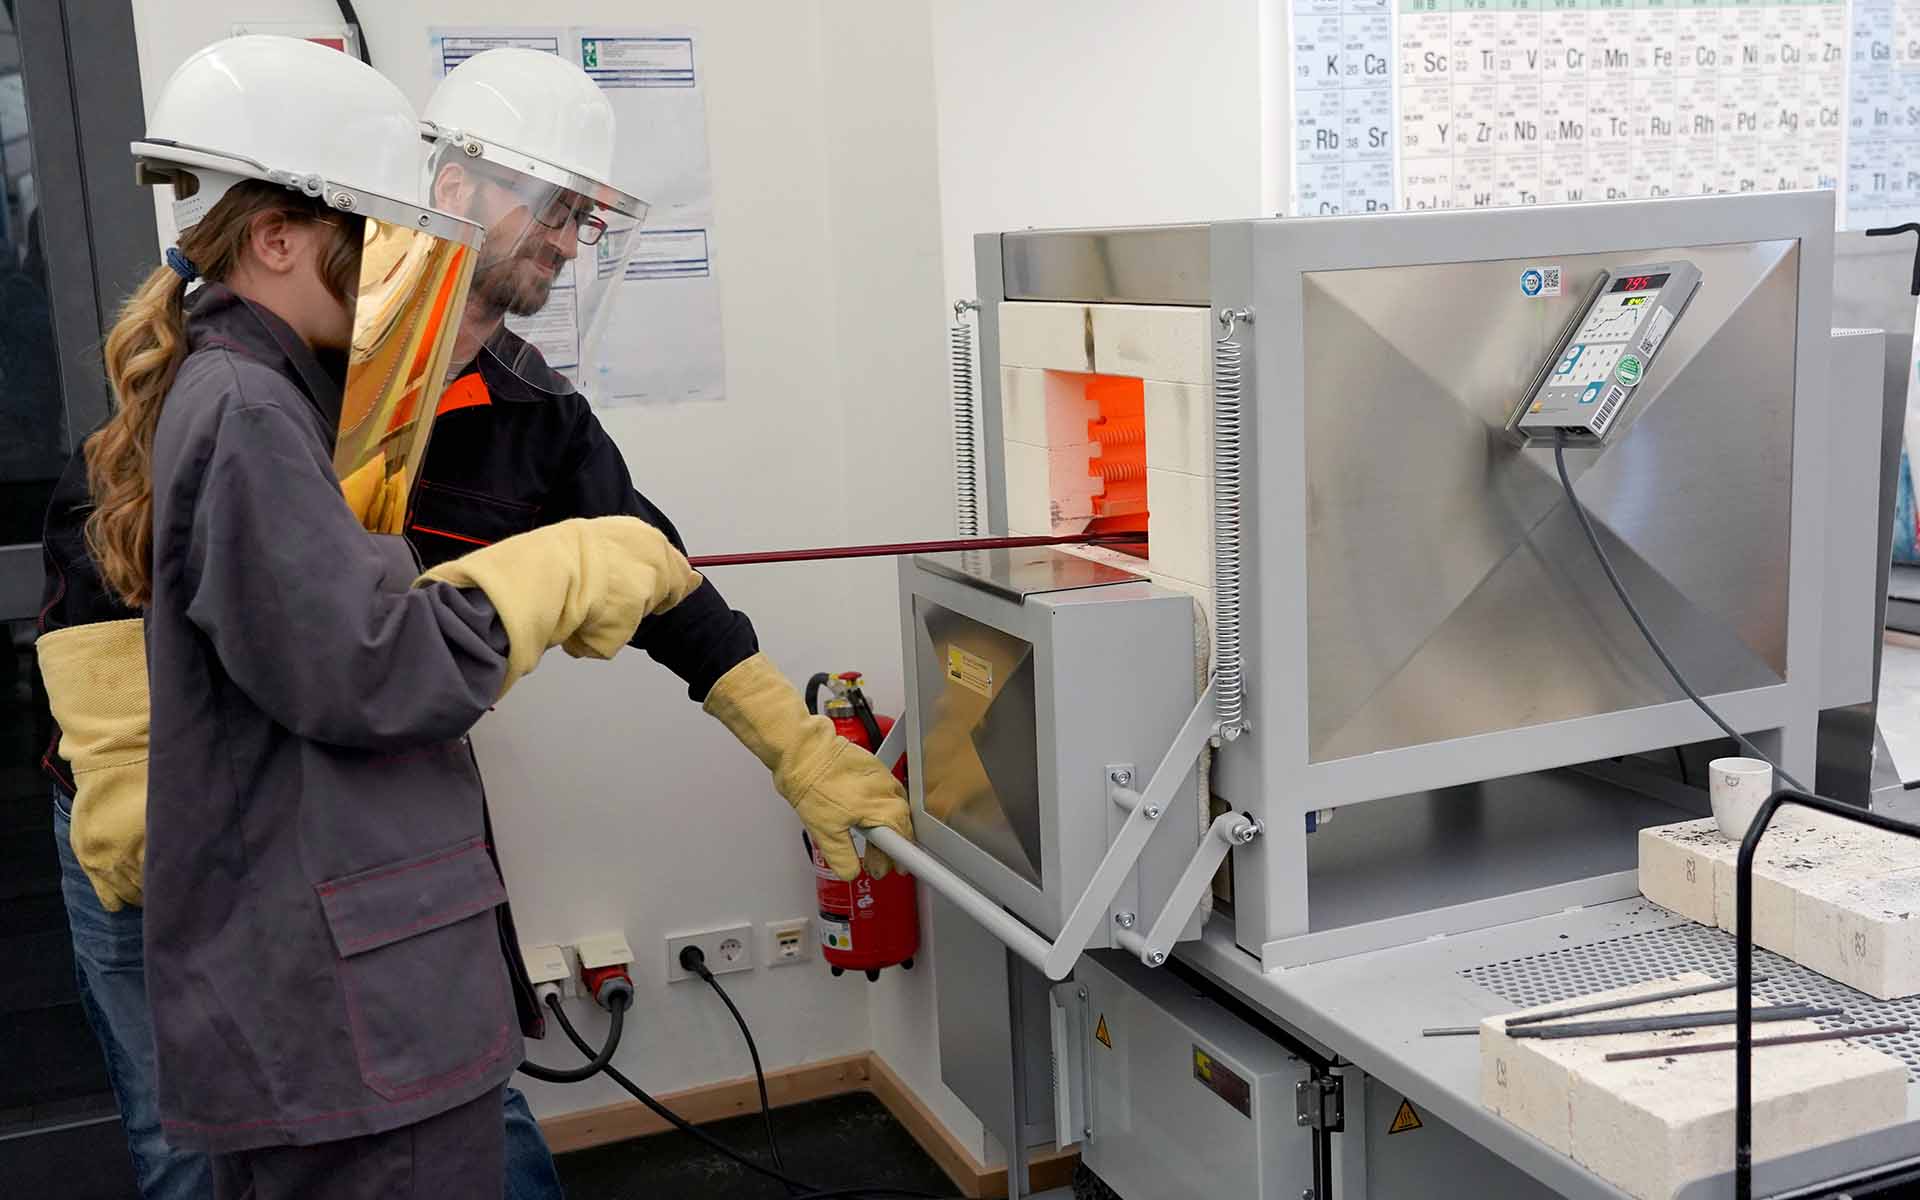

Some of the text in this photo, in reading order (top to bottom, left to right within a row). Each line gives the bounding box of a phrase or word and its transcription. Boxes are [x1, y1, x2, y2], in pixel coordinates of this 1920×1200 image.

[1424, 51, 1447, 73] Sc
[1480, 49, 1494, 71] Ti
[1527, 48, 1537, 70] V
[1566, 47, 1584, 69] Cr
[1604, 49, 1629, 68] Mn
[1654, 47, 1672, 67] Fe
[1696, 45, 1716, 66] Co
[1743, 45, 1758, 64] Ni
[1780, 43, 1800, 64] Cu
[1822, 42, 1840, 62] Zn
[1327, 54, 1338, 75] K
[1364, 53, 1387, 75] Ca
[1650, 115, 1672, 136] Ru
[1694, 114, 1714, 135] Rh
[1737, 112, 1756, 131] Pd
[1778, 109, 1798, 134] Ag
[1820, 106, 1839, 126] Cd
[1873, 106, 1888, 126] In
[1368, 126, 1389, 148] Sr
[1437, 123, 1449, 144] Y
[1477, 121, 1493, 143] Zr
[1514, 120, 1537, 141] Nb
[1559, 119, 1584, 140] Mo
[1609, 117, 1628, 137] Tc
[1316, 128, 1339, 150] Rb
[1873, 172, 1887, 191] Tl
